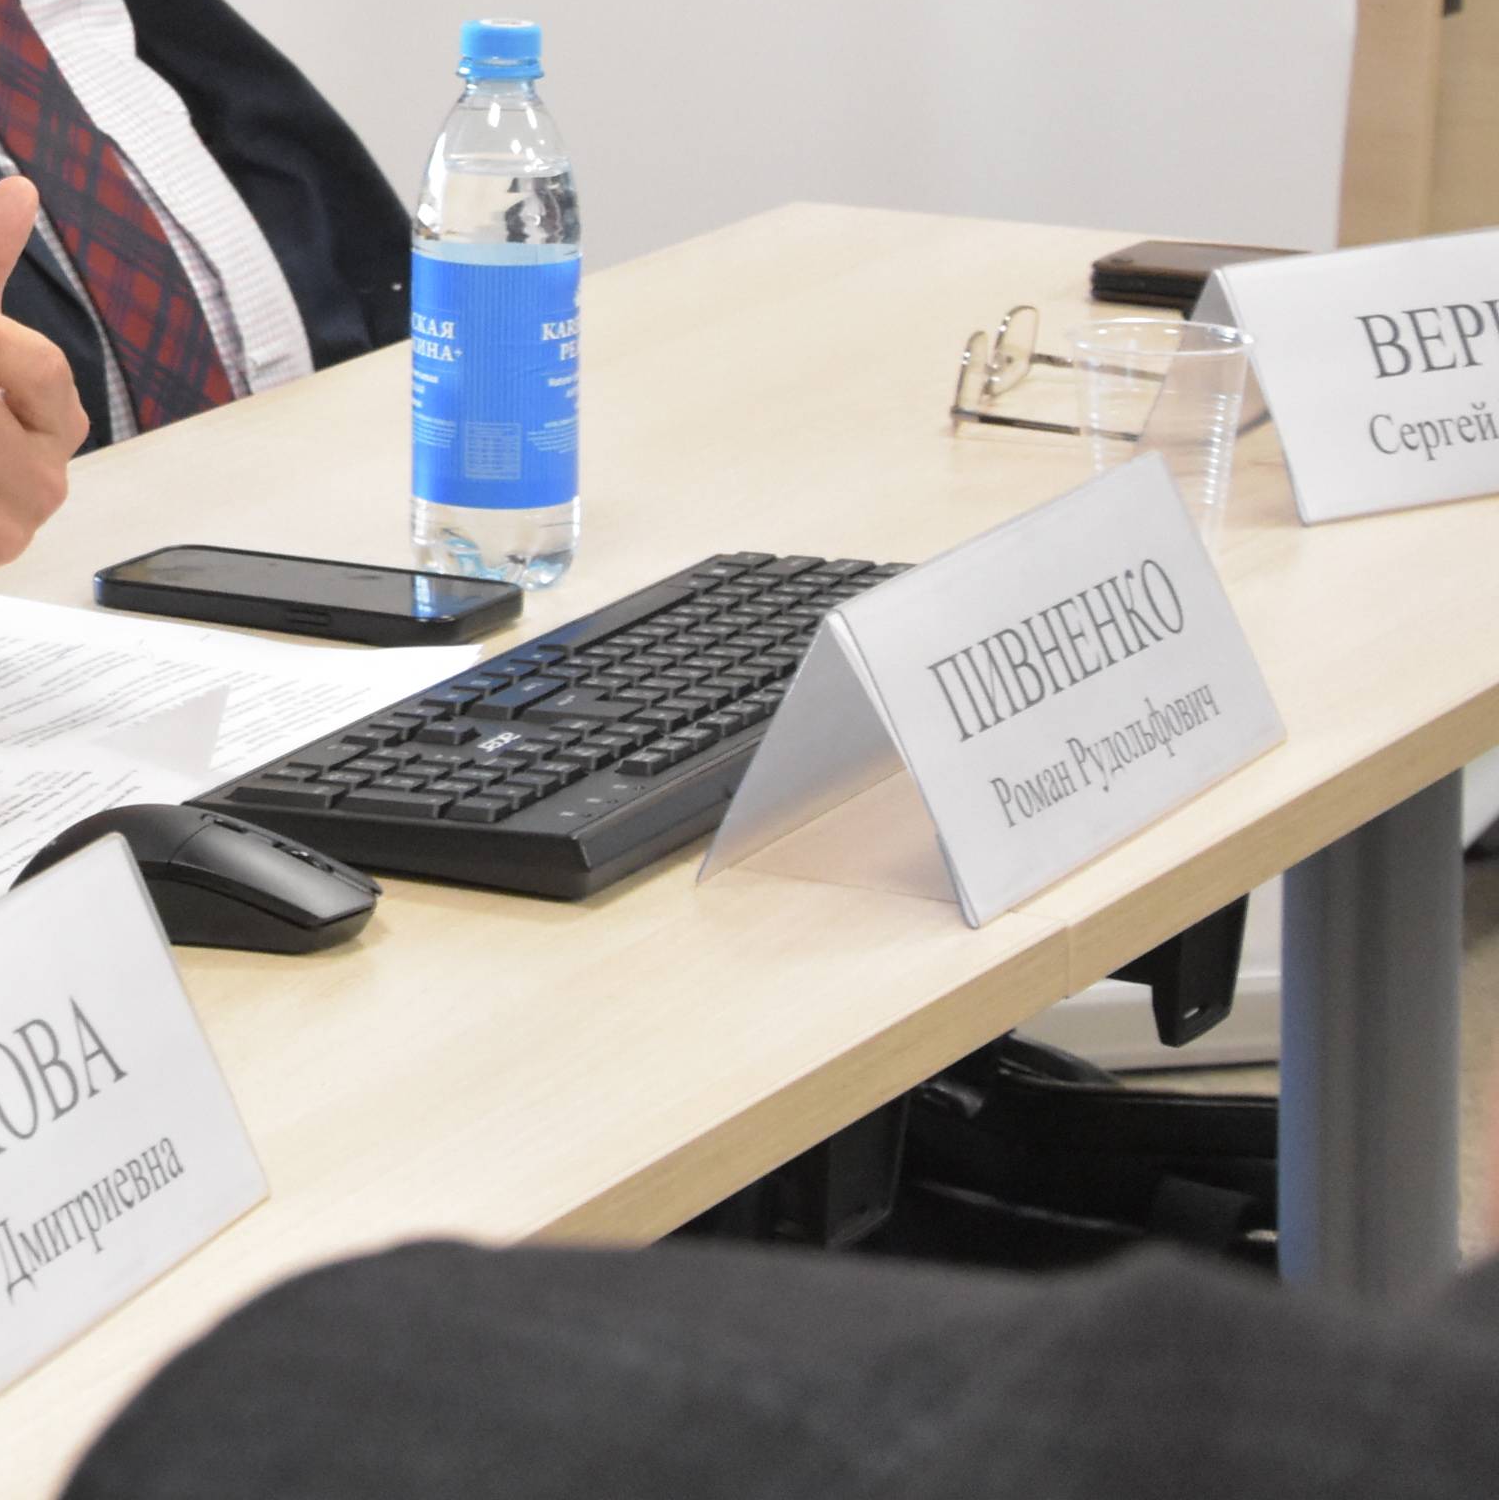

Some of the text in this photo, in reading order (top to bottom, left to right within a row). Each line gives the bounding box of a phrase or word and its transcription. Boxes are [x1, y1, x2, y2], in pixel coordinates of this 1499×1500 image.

[1369, 402, 1499, 461] Сергей
[926, 558, 1185, 743] ПИВНЕНКО
[989, 683, 1222, 829] Роман Рудольфович
